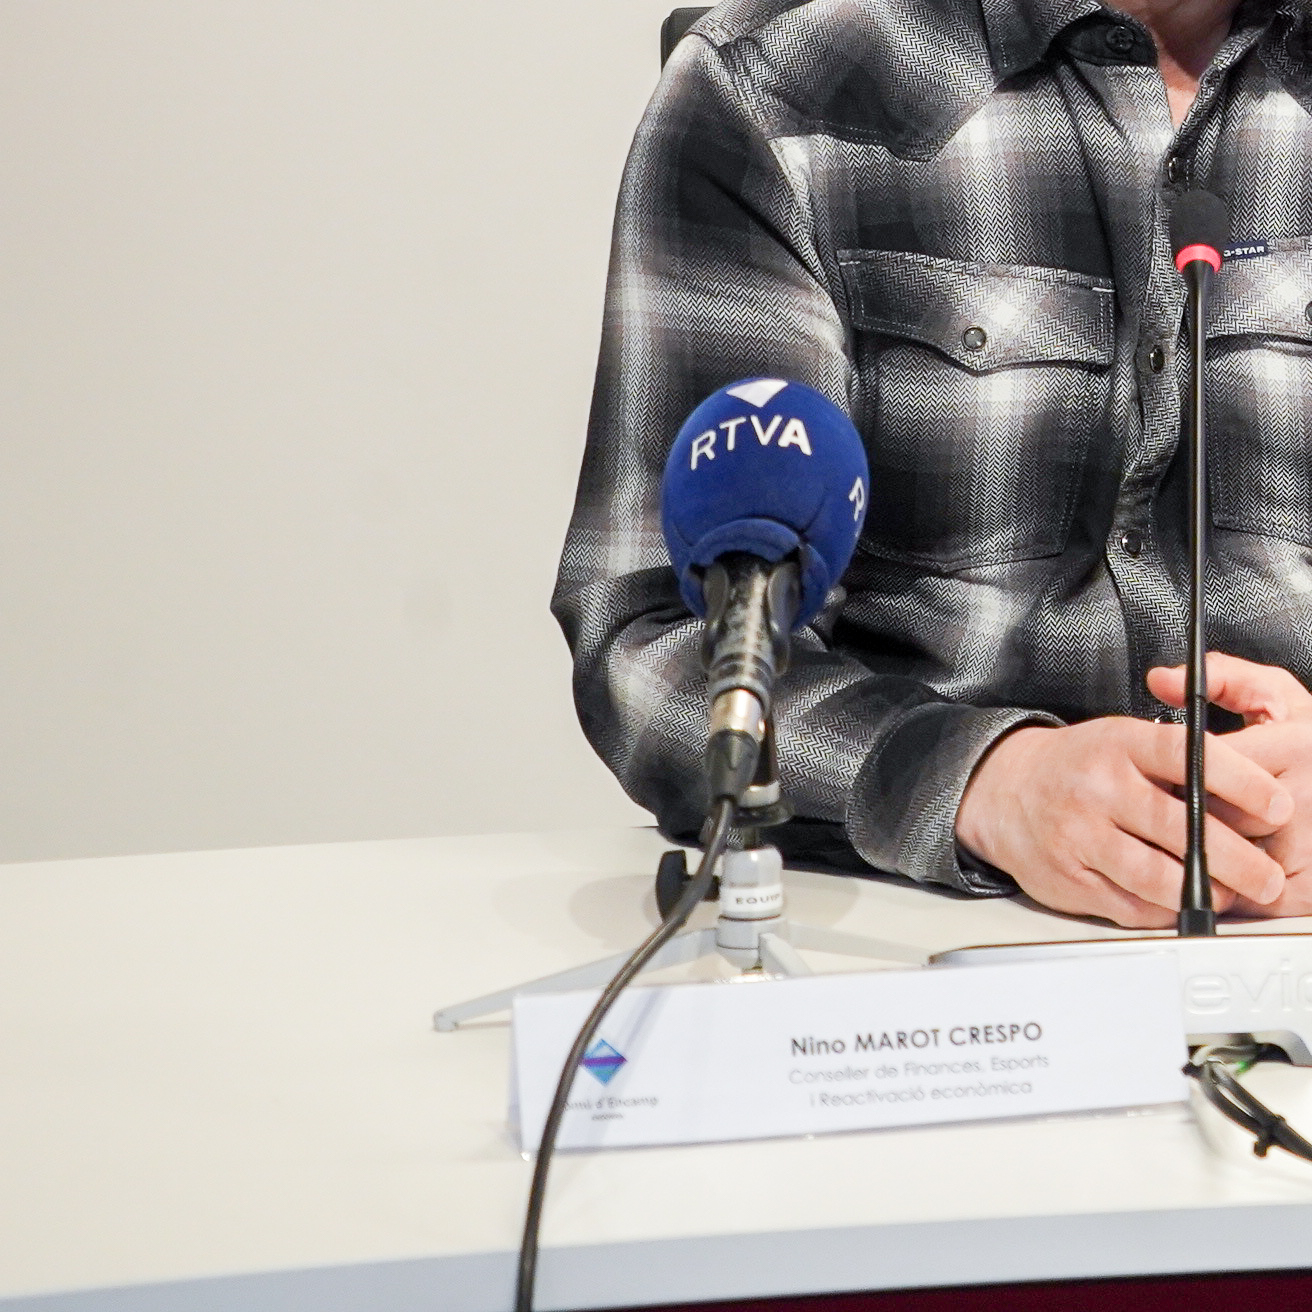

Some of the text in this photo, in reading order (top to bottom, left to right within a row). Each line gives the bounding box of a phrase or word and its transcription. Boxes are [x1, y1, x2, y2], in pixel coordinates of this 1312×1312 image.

[690, 414, 812, 471] RTVA
[791, 1022, 1042, 1057] Nino MAROT CRESPO
[788, 1066, 869, 1085] Conseller
[874, 1064, 899, 1079] de
[990, 1054, 1050, 1072] Esports
